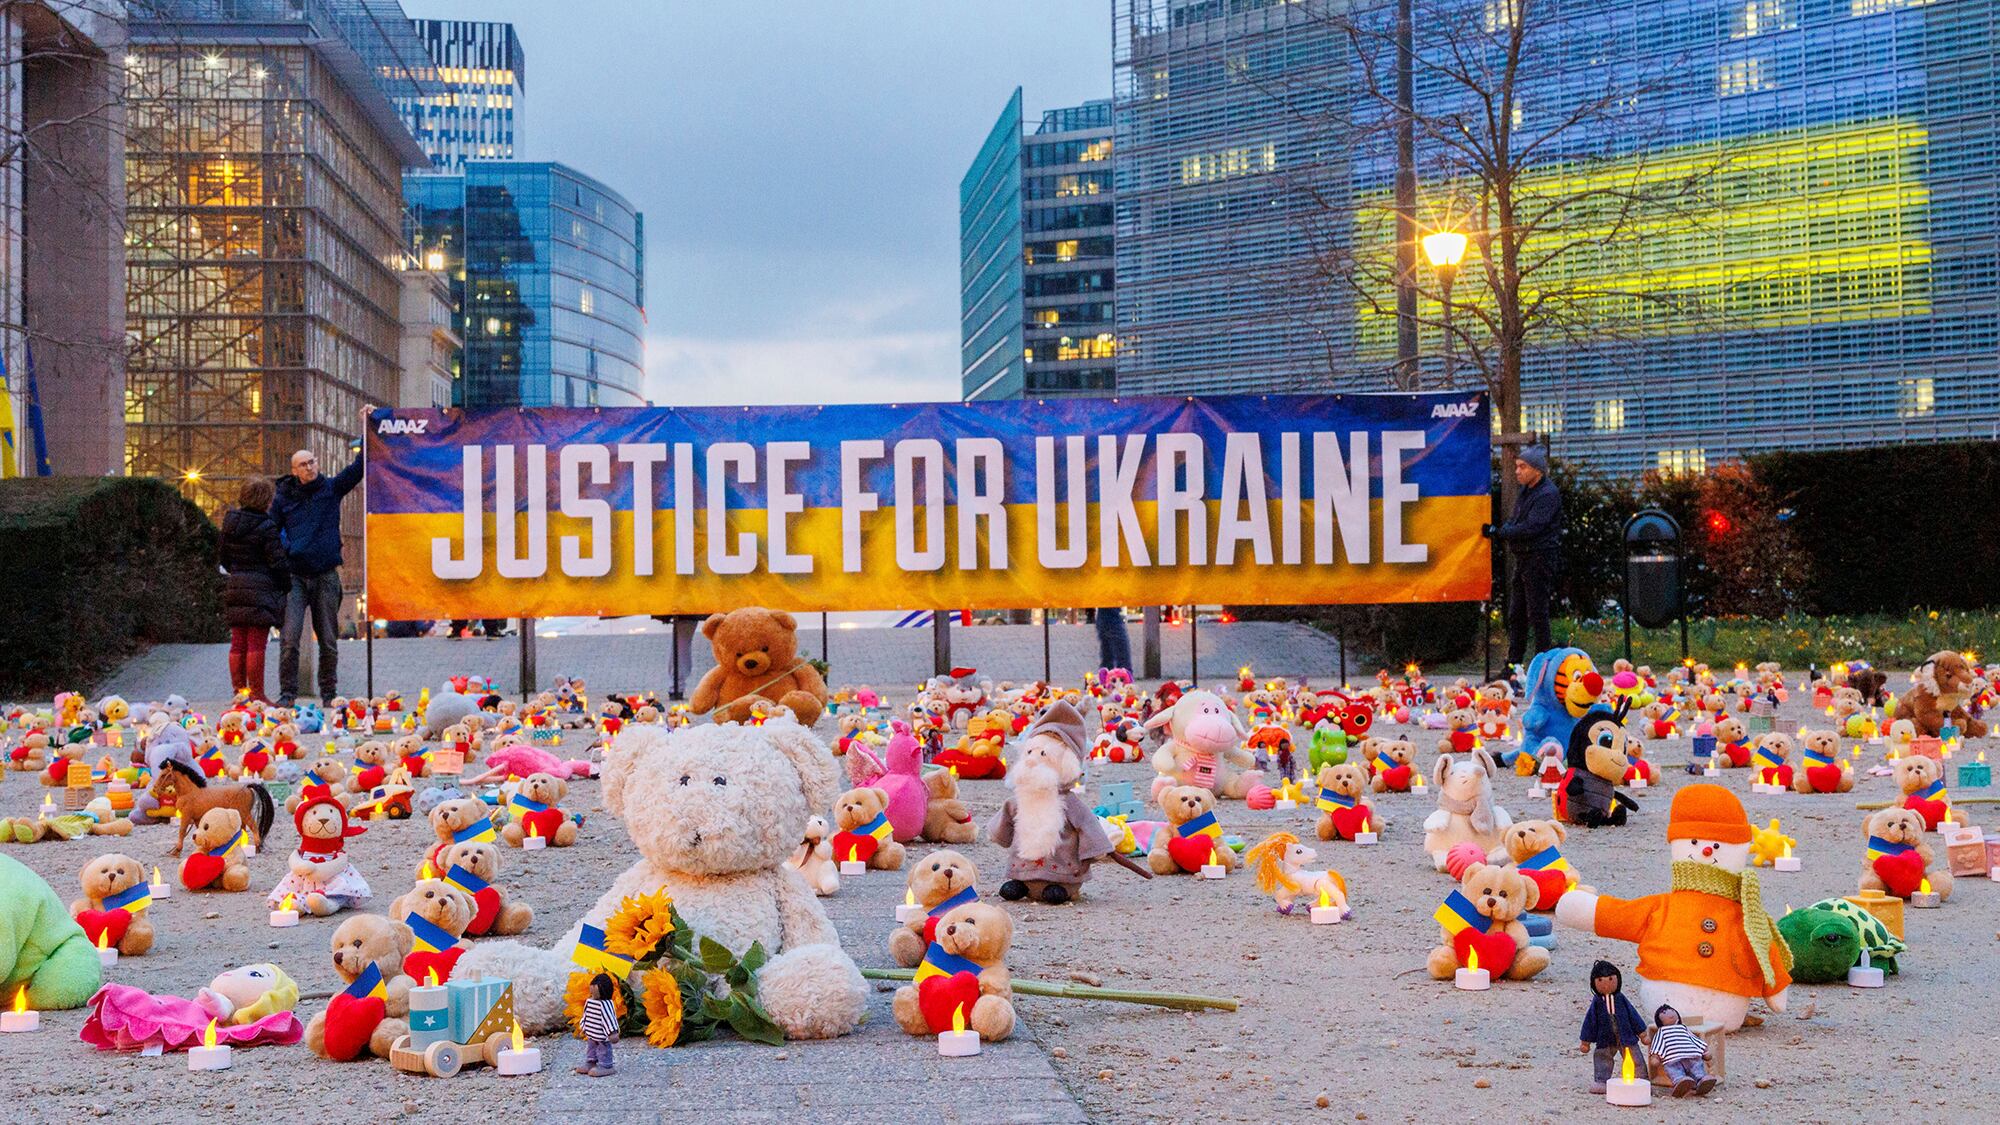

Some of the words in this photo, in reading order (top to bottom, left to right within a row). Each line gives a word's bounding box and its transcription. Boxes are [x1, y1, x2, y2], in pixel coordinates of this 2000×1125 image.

[1431, 402, 1479, 419] AVAAZ
[378, 419, 428, 434] AVAAZ
[431, 441, 814, 580] JUSTICE
[840, 437, 1009, 573] FOR
[1035, 430, 1428, 570] UKRAINE
